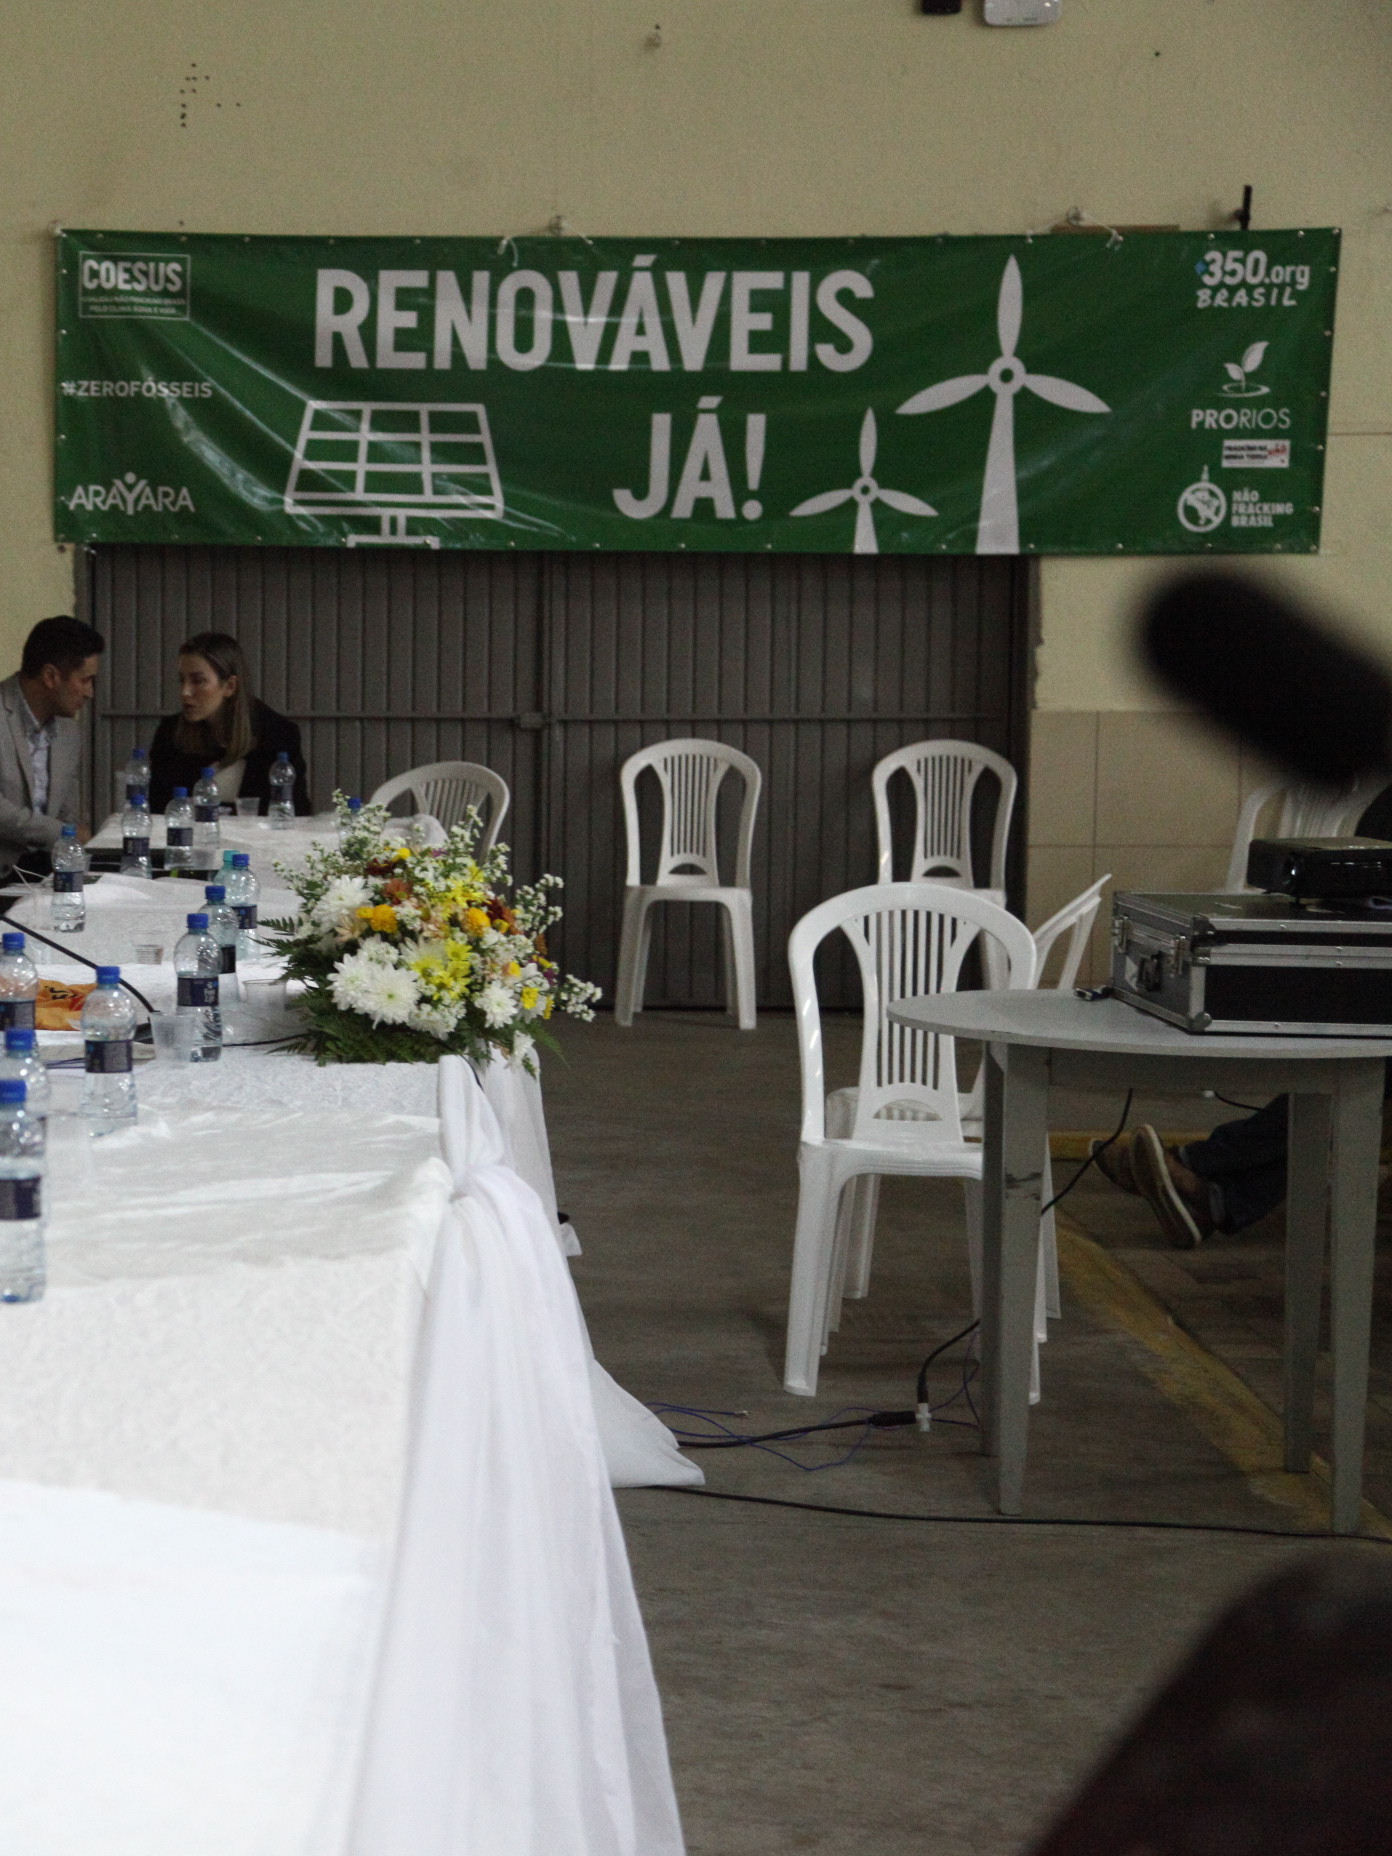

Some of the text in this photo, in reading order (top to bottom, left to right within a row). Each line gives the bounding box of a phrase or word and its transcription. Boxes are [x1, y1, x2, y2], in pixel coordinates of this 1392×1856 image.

[83, 259, 183, 293] COESUS
[1202, 250, 1311, 290] 350.org
[1196, 286, 1297, 309] BRASIL
[314, 254, 875, 372] RENOVÁVEIS
[61, 375, 213, 399] #ZEROFÓSSEIS
[1190, 408, 1292, 430] PRORIOS
[612, 395, 767, 521] JÁ!
[68, 471, 196, 517] ARAYARA
[1232, 487, 1259, 502] NÃO
[1232, 502, 1294, 515] FRACKING
[1231, 515, 1274, 528] BRASIL
